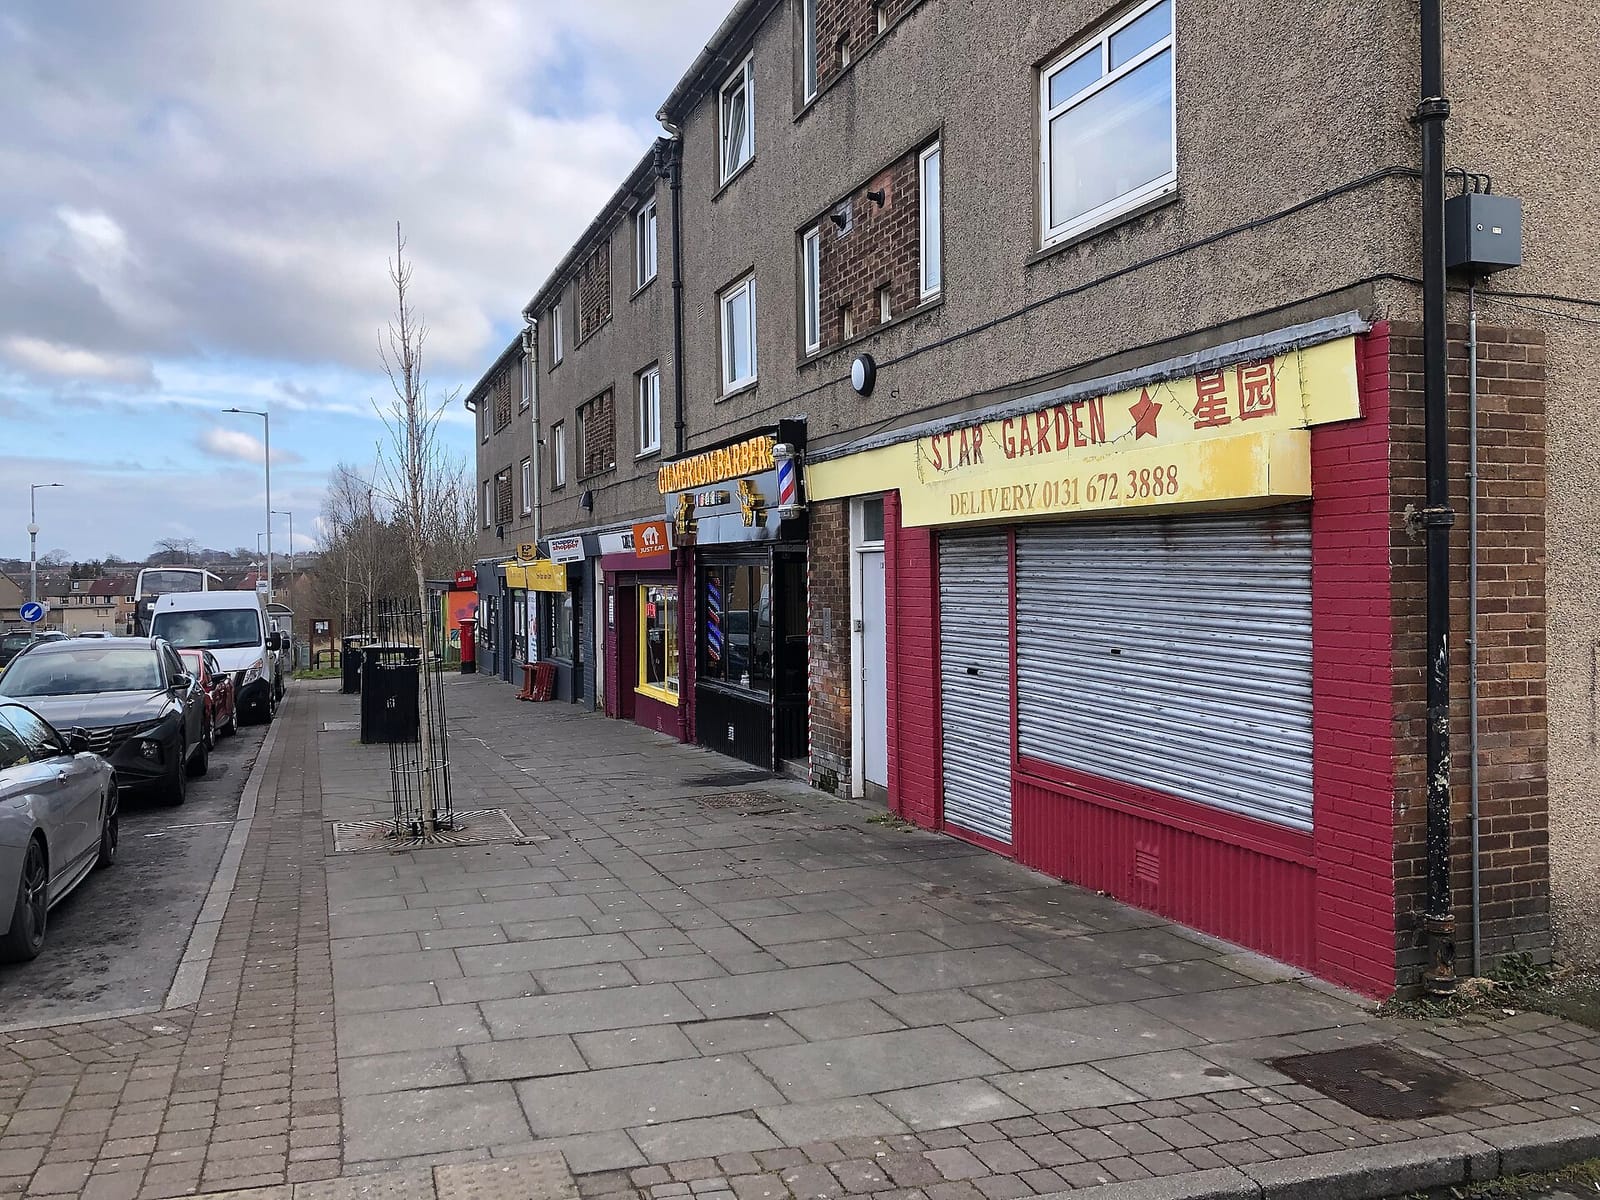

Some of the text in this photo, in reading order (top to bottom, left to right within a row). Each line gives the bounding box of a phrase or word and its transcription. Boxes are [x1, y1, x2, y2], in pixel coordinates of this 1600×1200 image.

[1193, 356, 1277, 429] 星园
[931, 396, 1106, 471] STAR GARDEN
[658, 449, 716, 494] GILMERTON
[950, 465, 1179, 516] DELIVERY 0131 672 3888
